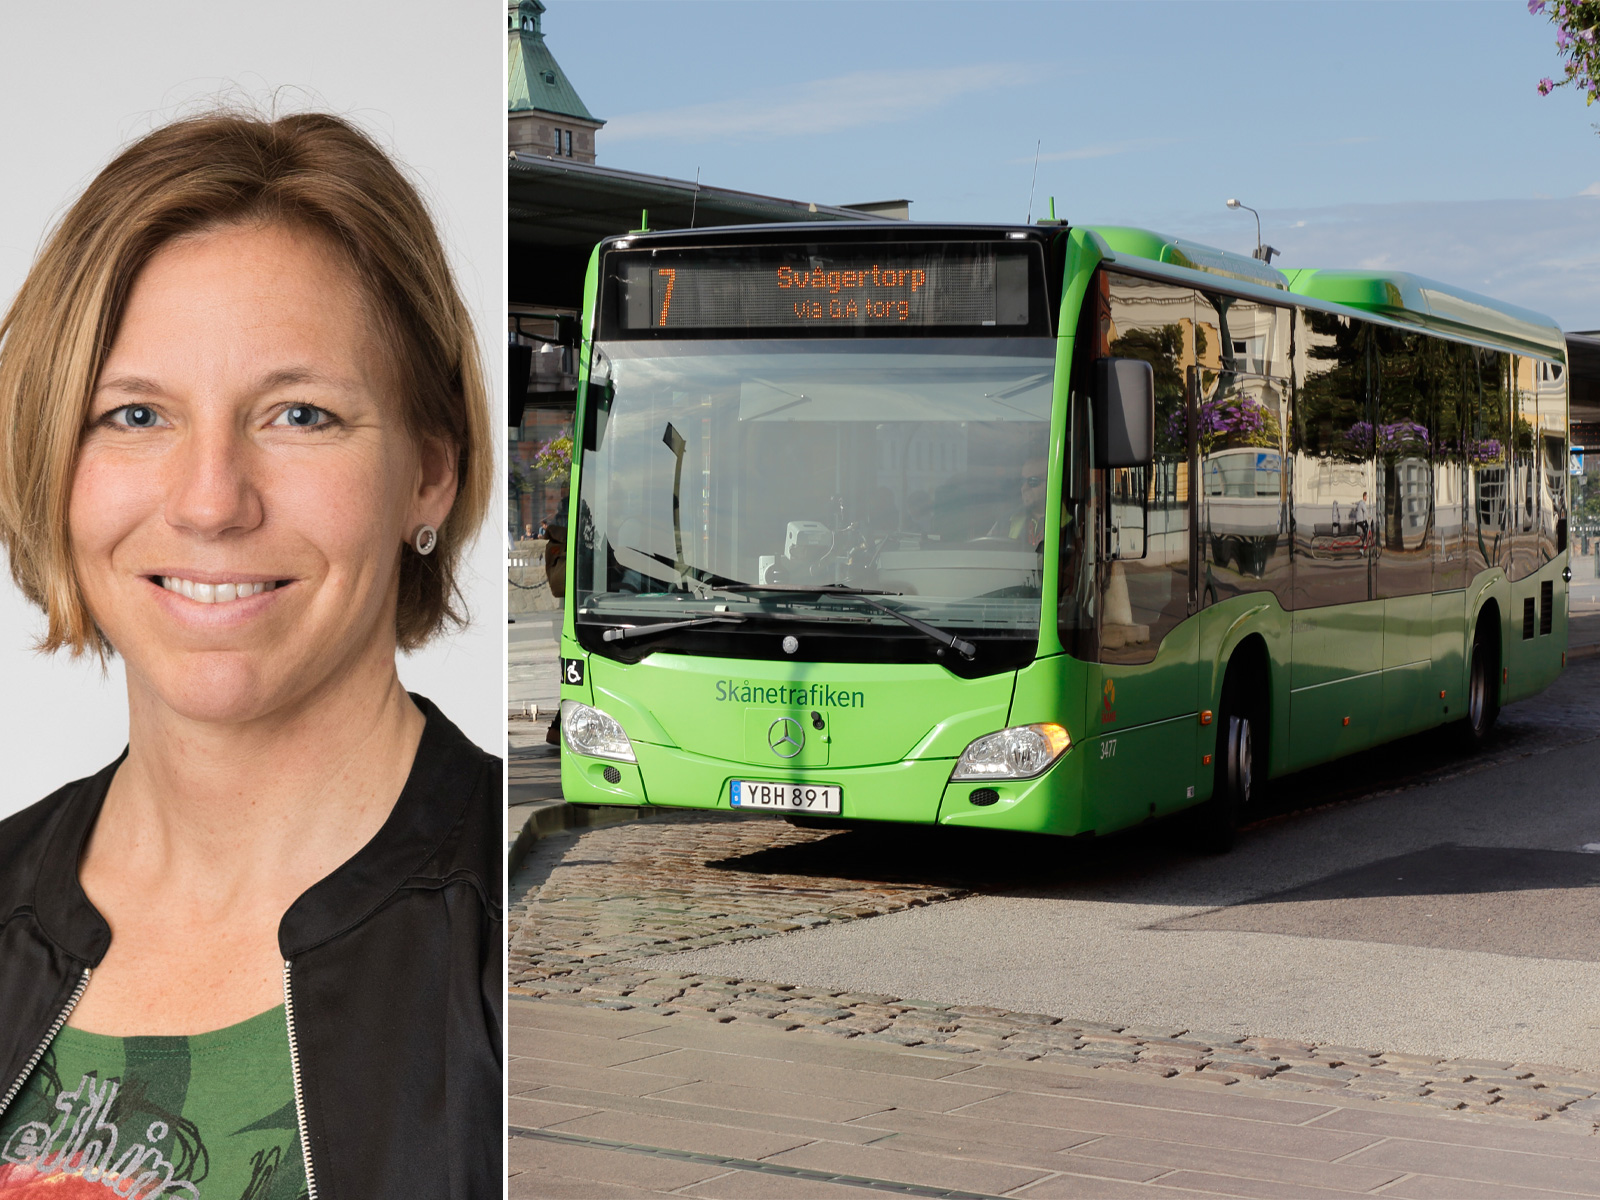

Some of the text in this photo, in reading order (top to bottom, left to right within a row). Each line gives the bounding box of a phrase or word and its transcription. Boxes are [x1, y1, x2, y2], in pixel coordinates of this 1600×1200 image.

[777, 264, 926, 294] Svågertorp
[658, 268, 676, 327] 7
[794, 298, 909, 320] via G.A torg
[715, 679, 865, 708] Skånetrafiken
[1100, 739, 1117, 759] 3477
[748, 784, 829, 809] YBH 891
